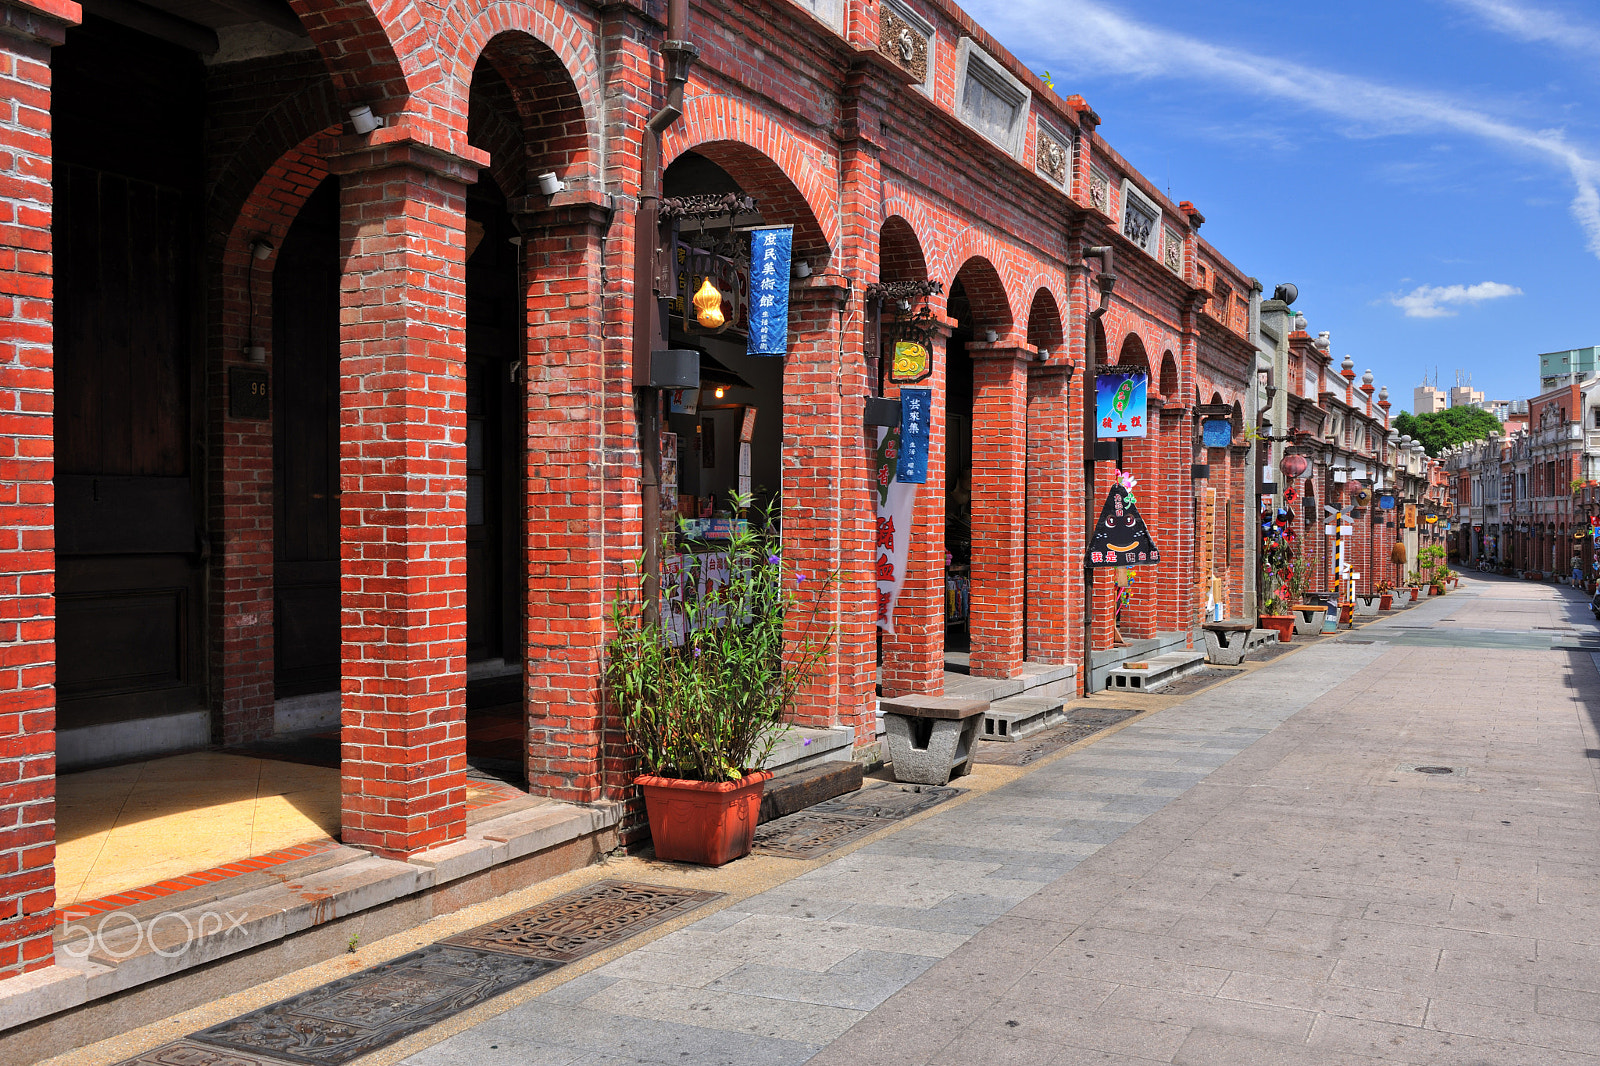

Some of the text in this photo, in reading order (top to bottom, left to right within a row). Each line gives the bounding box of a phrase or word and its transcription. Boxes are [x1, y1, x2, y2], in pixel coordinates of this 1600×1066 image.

[760, 232, 777, 307] 庶民美術館
[251, 382, 266, 395] 96
[1091, 551, 1117, 563] 我是
